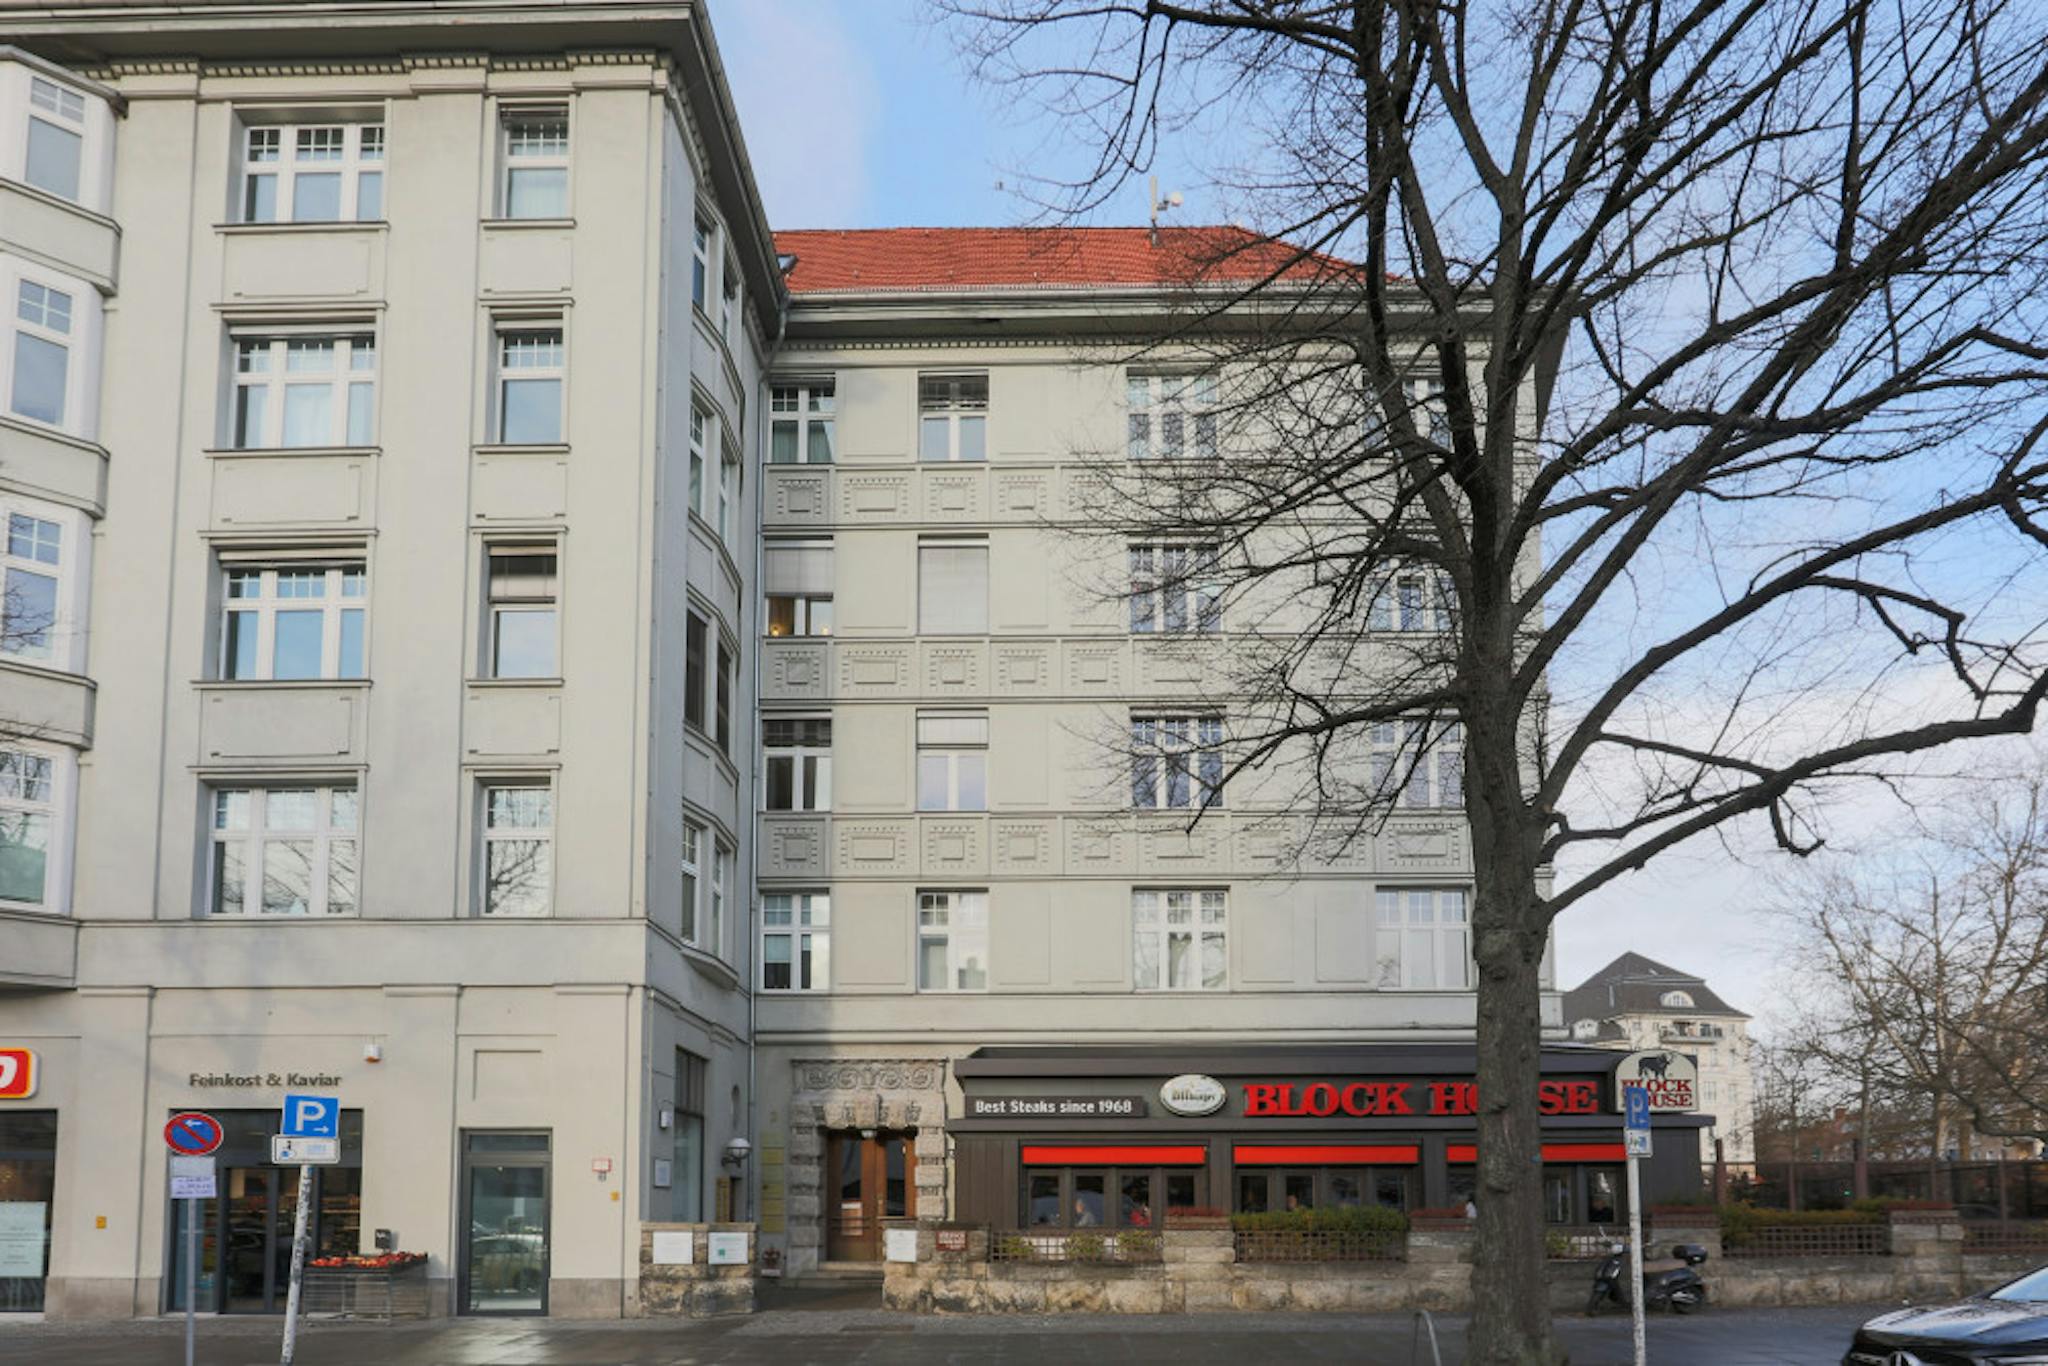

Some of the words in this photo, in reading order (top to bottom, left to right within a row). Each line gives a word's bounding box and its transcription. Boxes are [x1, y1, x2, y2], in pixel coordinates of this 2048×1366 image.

[189, 1073, 262, 1087] Feinkost
[266, 1073, 282, 1087] &
[287, 1073, 342, 1087] Kaviar
[975, 1100, 1006, 1114] Best
[1010, 1100, 1056, 1114] Steaks
[1060, 1100, 1095, 1114] since
[1098, 1100, 1132, 1114] 1968
[1242, 1082, 1414, 1117] BLOCK
[1426, 1081, 1598, 1115] HSE
[296, 1101, 326, 1132] P
